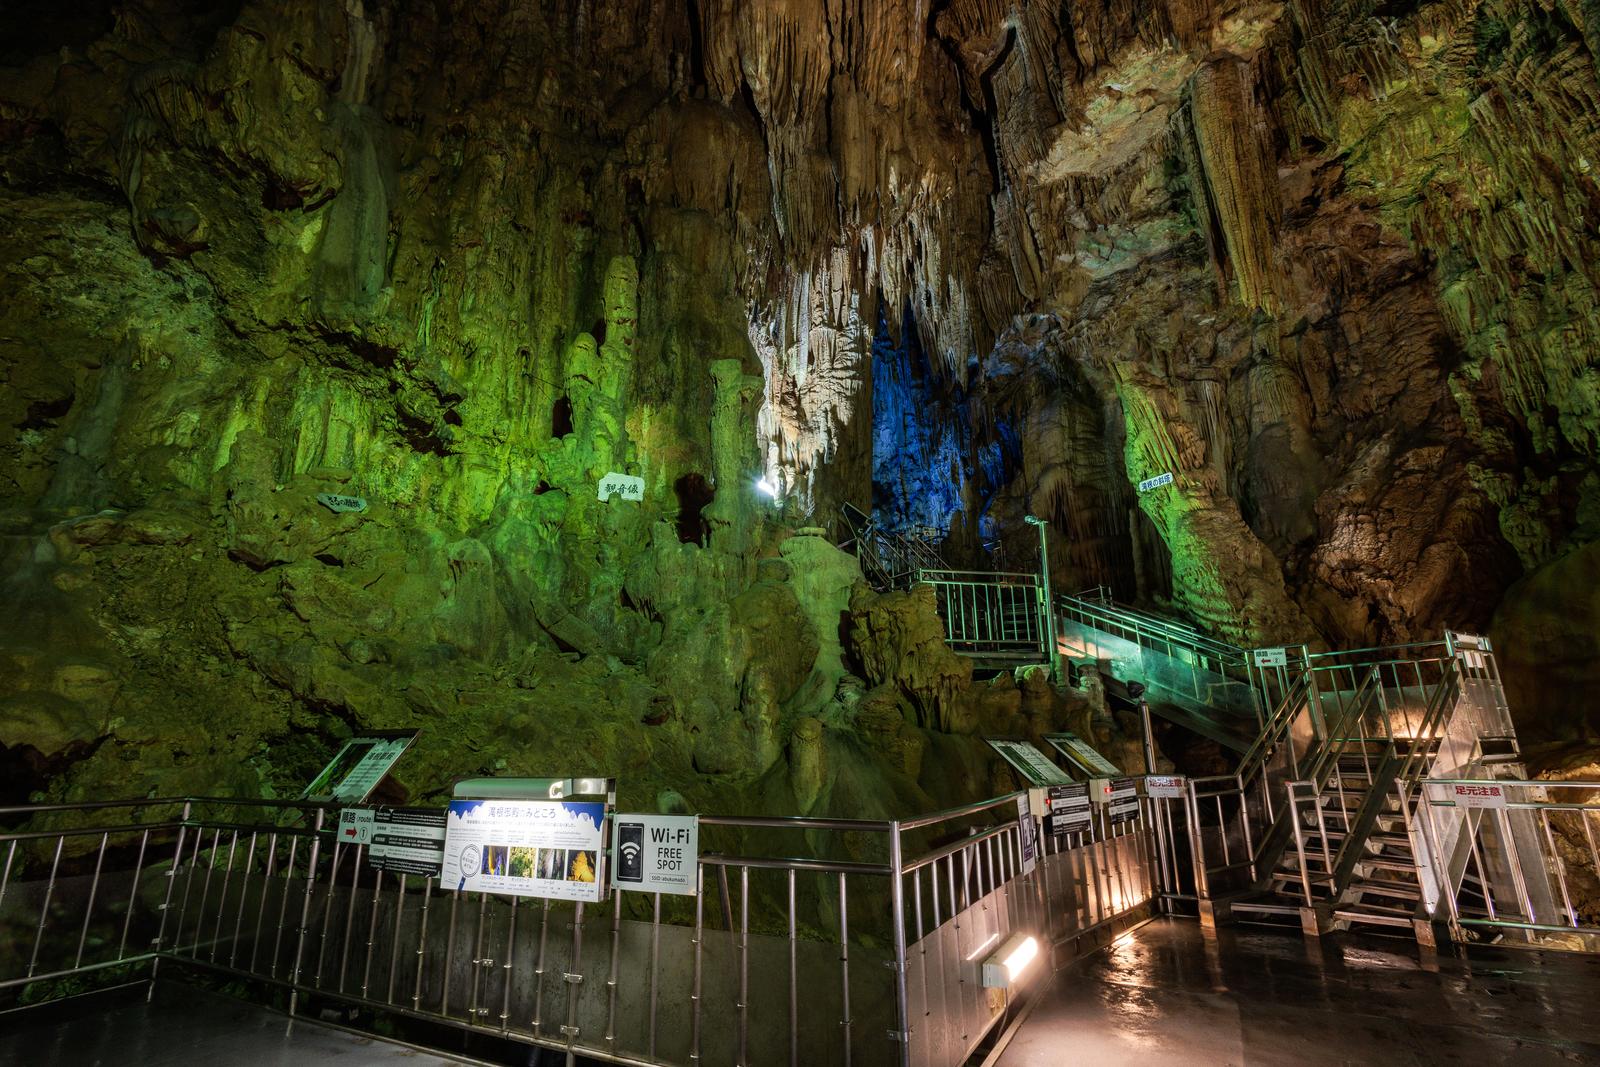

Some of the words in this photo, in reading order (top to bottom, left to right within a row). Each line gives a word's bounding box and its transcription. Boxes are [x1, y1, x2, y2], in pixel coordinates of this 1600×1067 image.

[605, 483, 639, 494] 観音像
[1455, 785, 1501, 796] 足元注意
[651, 828, 690, 844] Wi-Fi
[657, 848, 682, 859] FREE
[657, 860, 682, 870] SPOT
